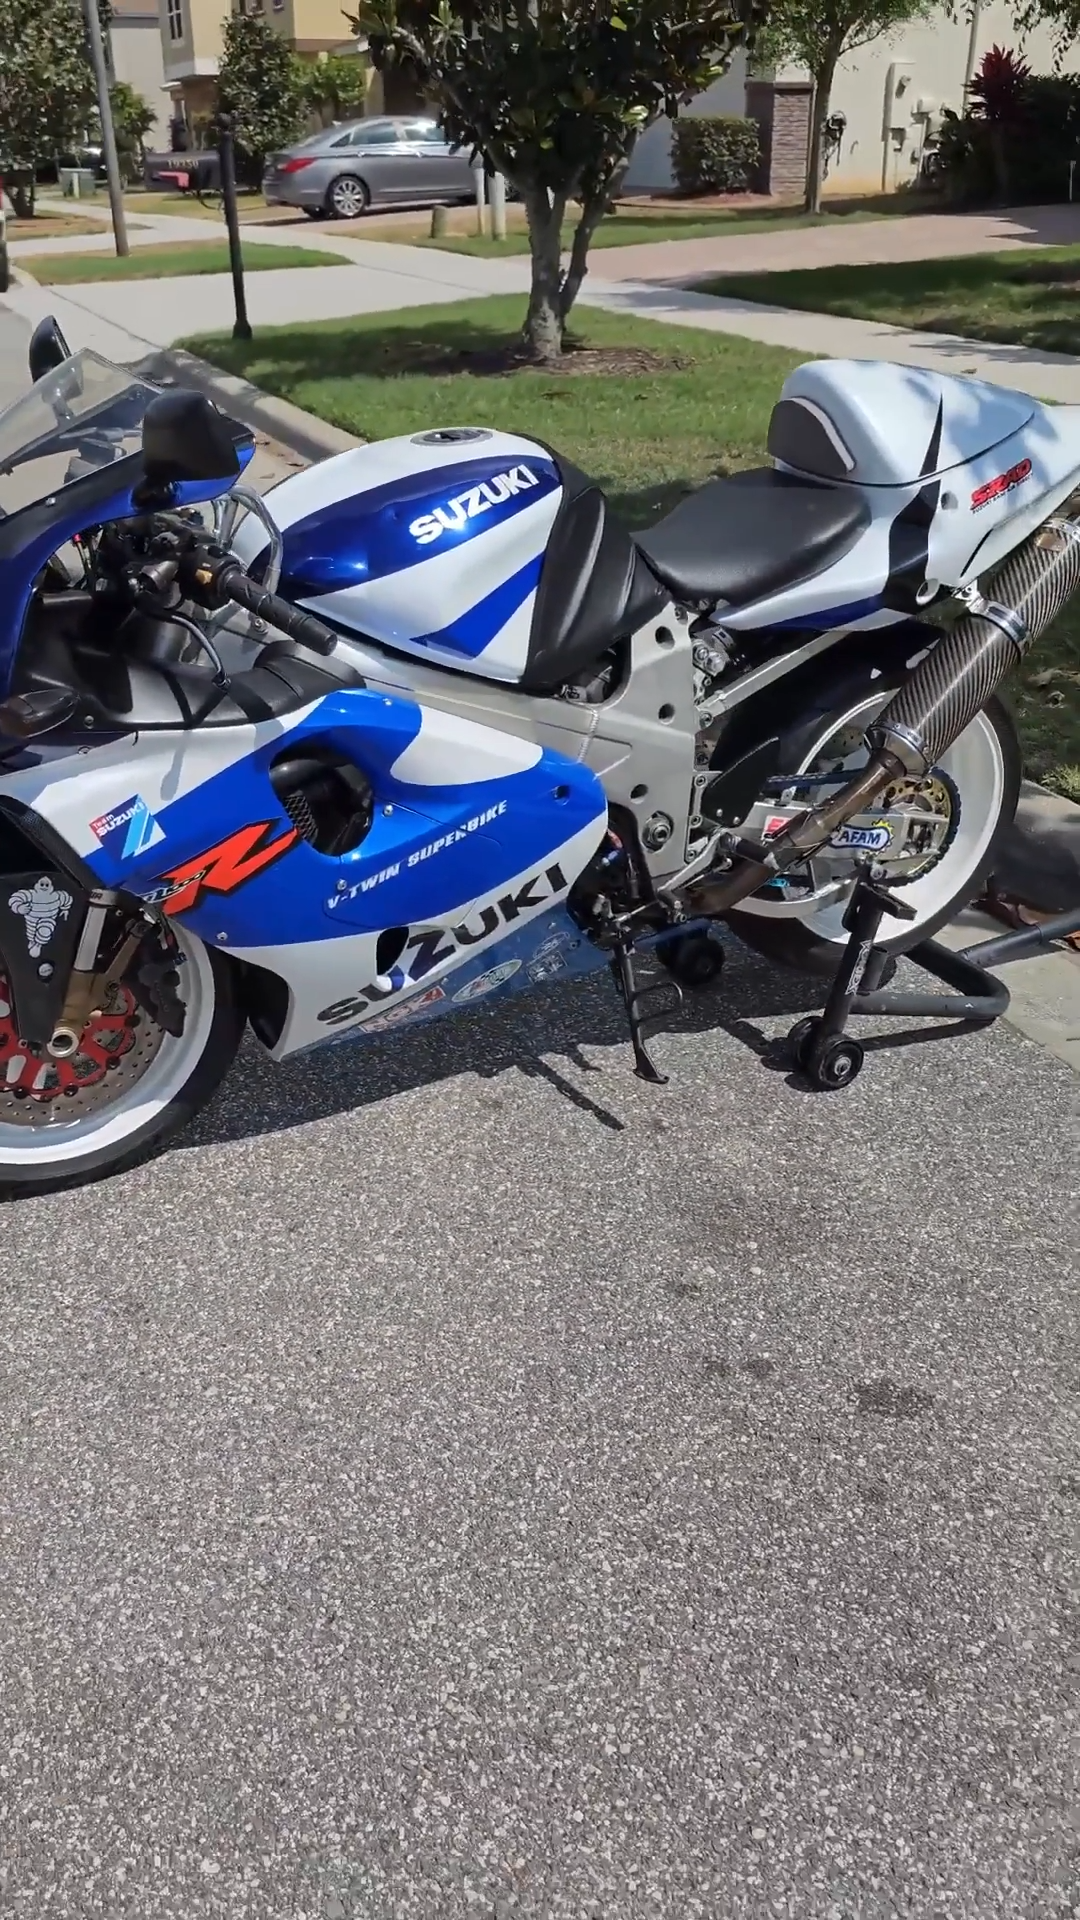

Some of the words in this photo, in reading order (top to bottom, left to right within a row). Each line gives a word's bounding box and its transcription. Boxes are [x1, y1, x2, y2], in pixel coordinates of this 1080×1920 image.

[409, 464, 539, 544] SUZUKI
[970, 458, 1032, 510] SRAD
[96, 802, 146, 837] SUZUKI
[838, 830, 882, 846] AFAM
[327, 861, 401, 909] V-TWIN
[407, 799, 508, 868] SUPERBIKE
[316, 862, 568, 1026] SUZUKI
